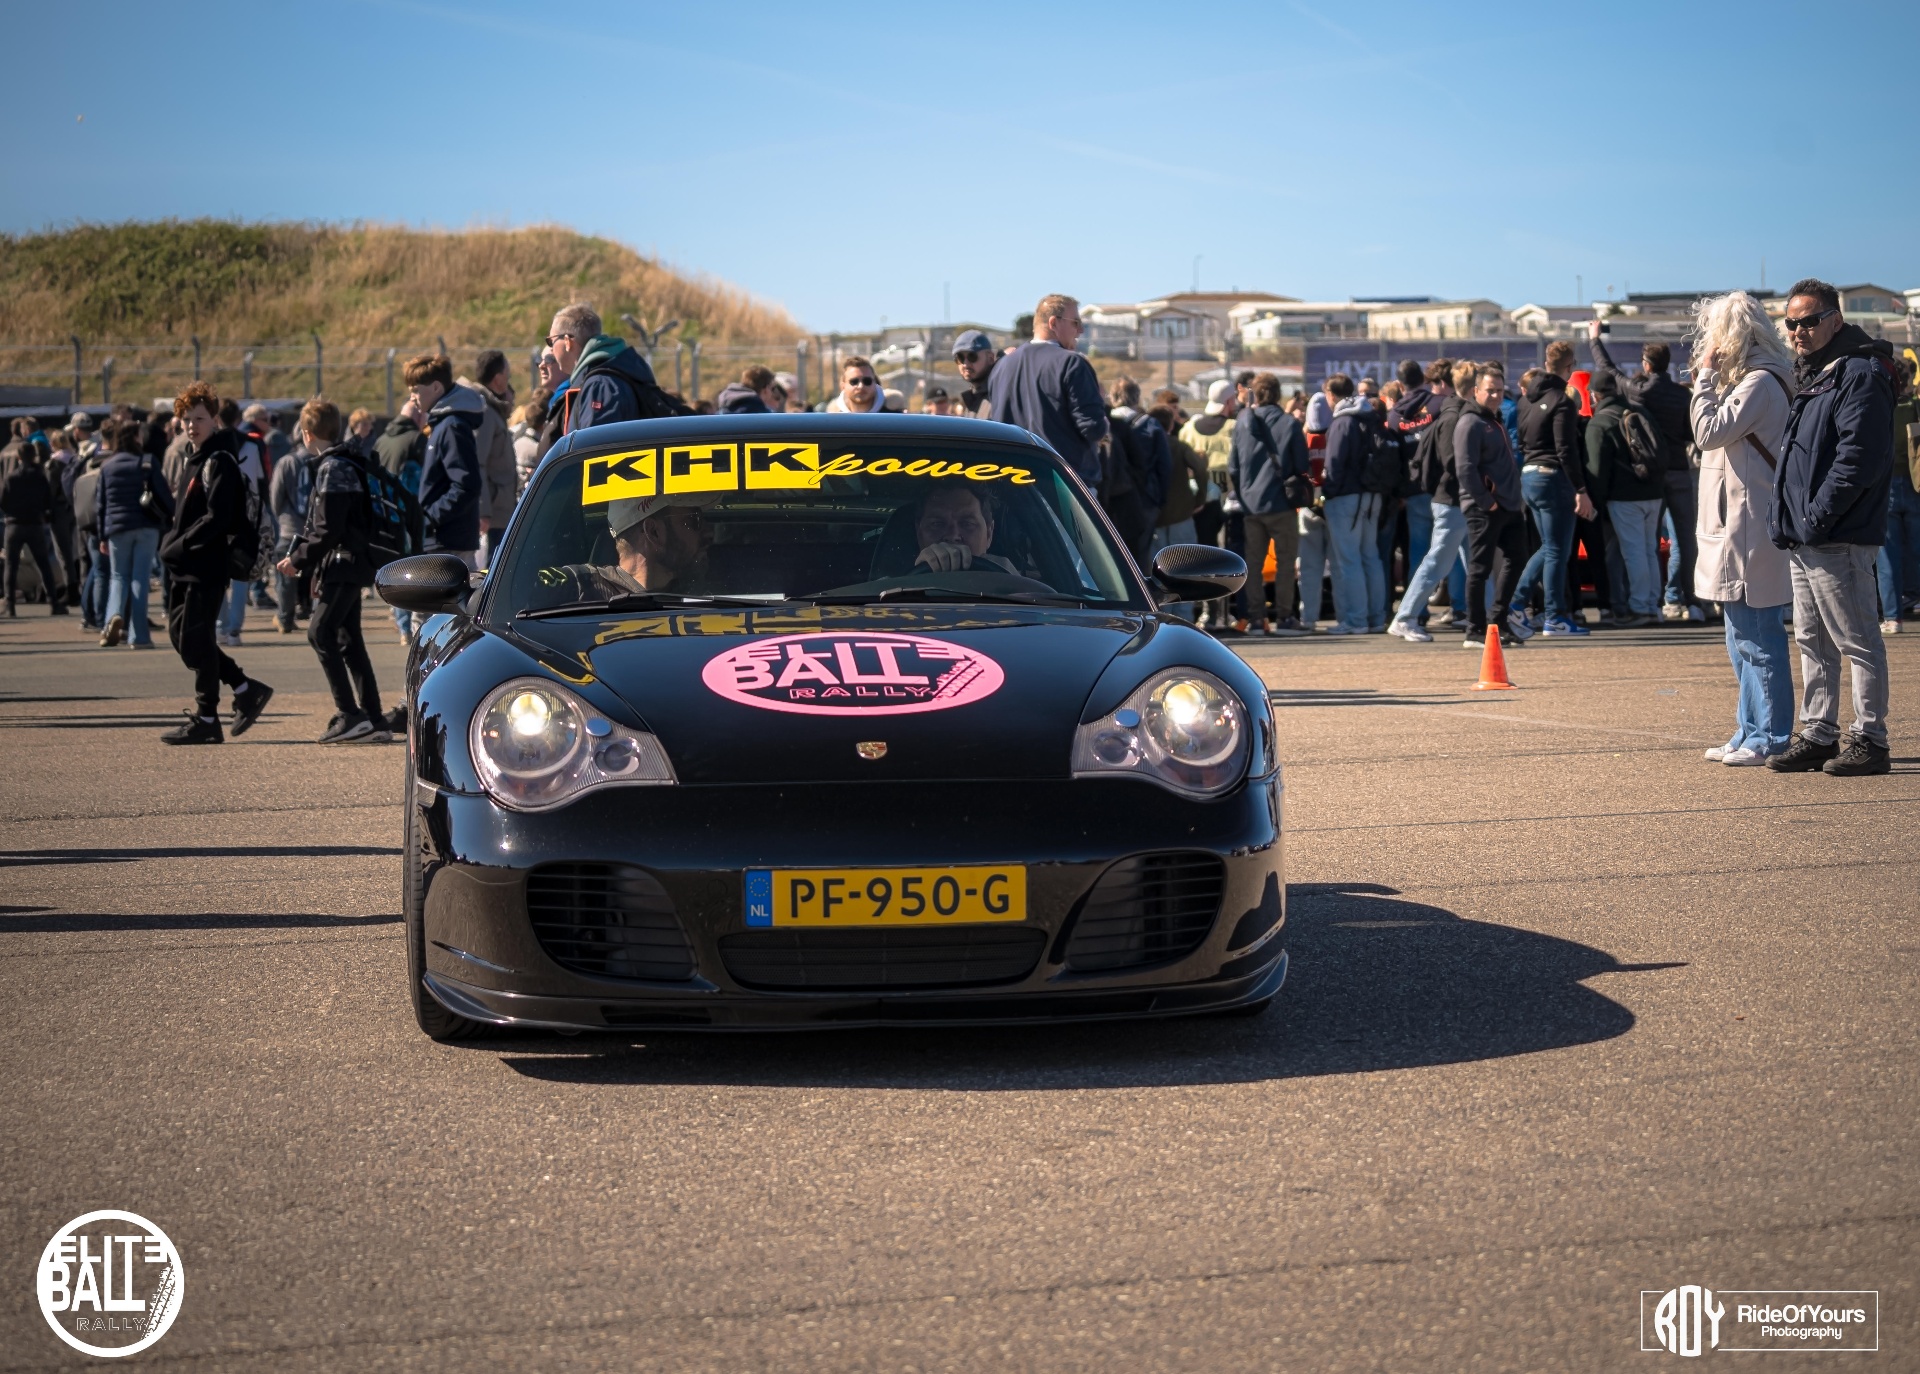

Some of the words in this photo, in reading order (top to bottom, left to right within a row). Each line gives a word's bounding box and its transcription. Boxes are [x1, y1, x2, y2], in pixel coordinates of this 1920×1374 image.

[587, 446, 818, 488] KHK
[808, 453, 1036, 485] power
[789, 685, 931, 699] RALLY
[790, 874, 1010, 918] PF-950-G
[750, 904, 769, 917] NL
